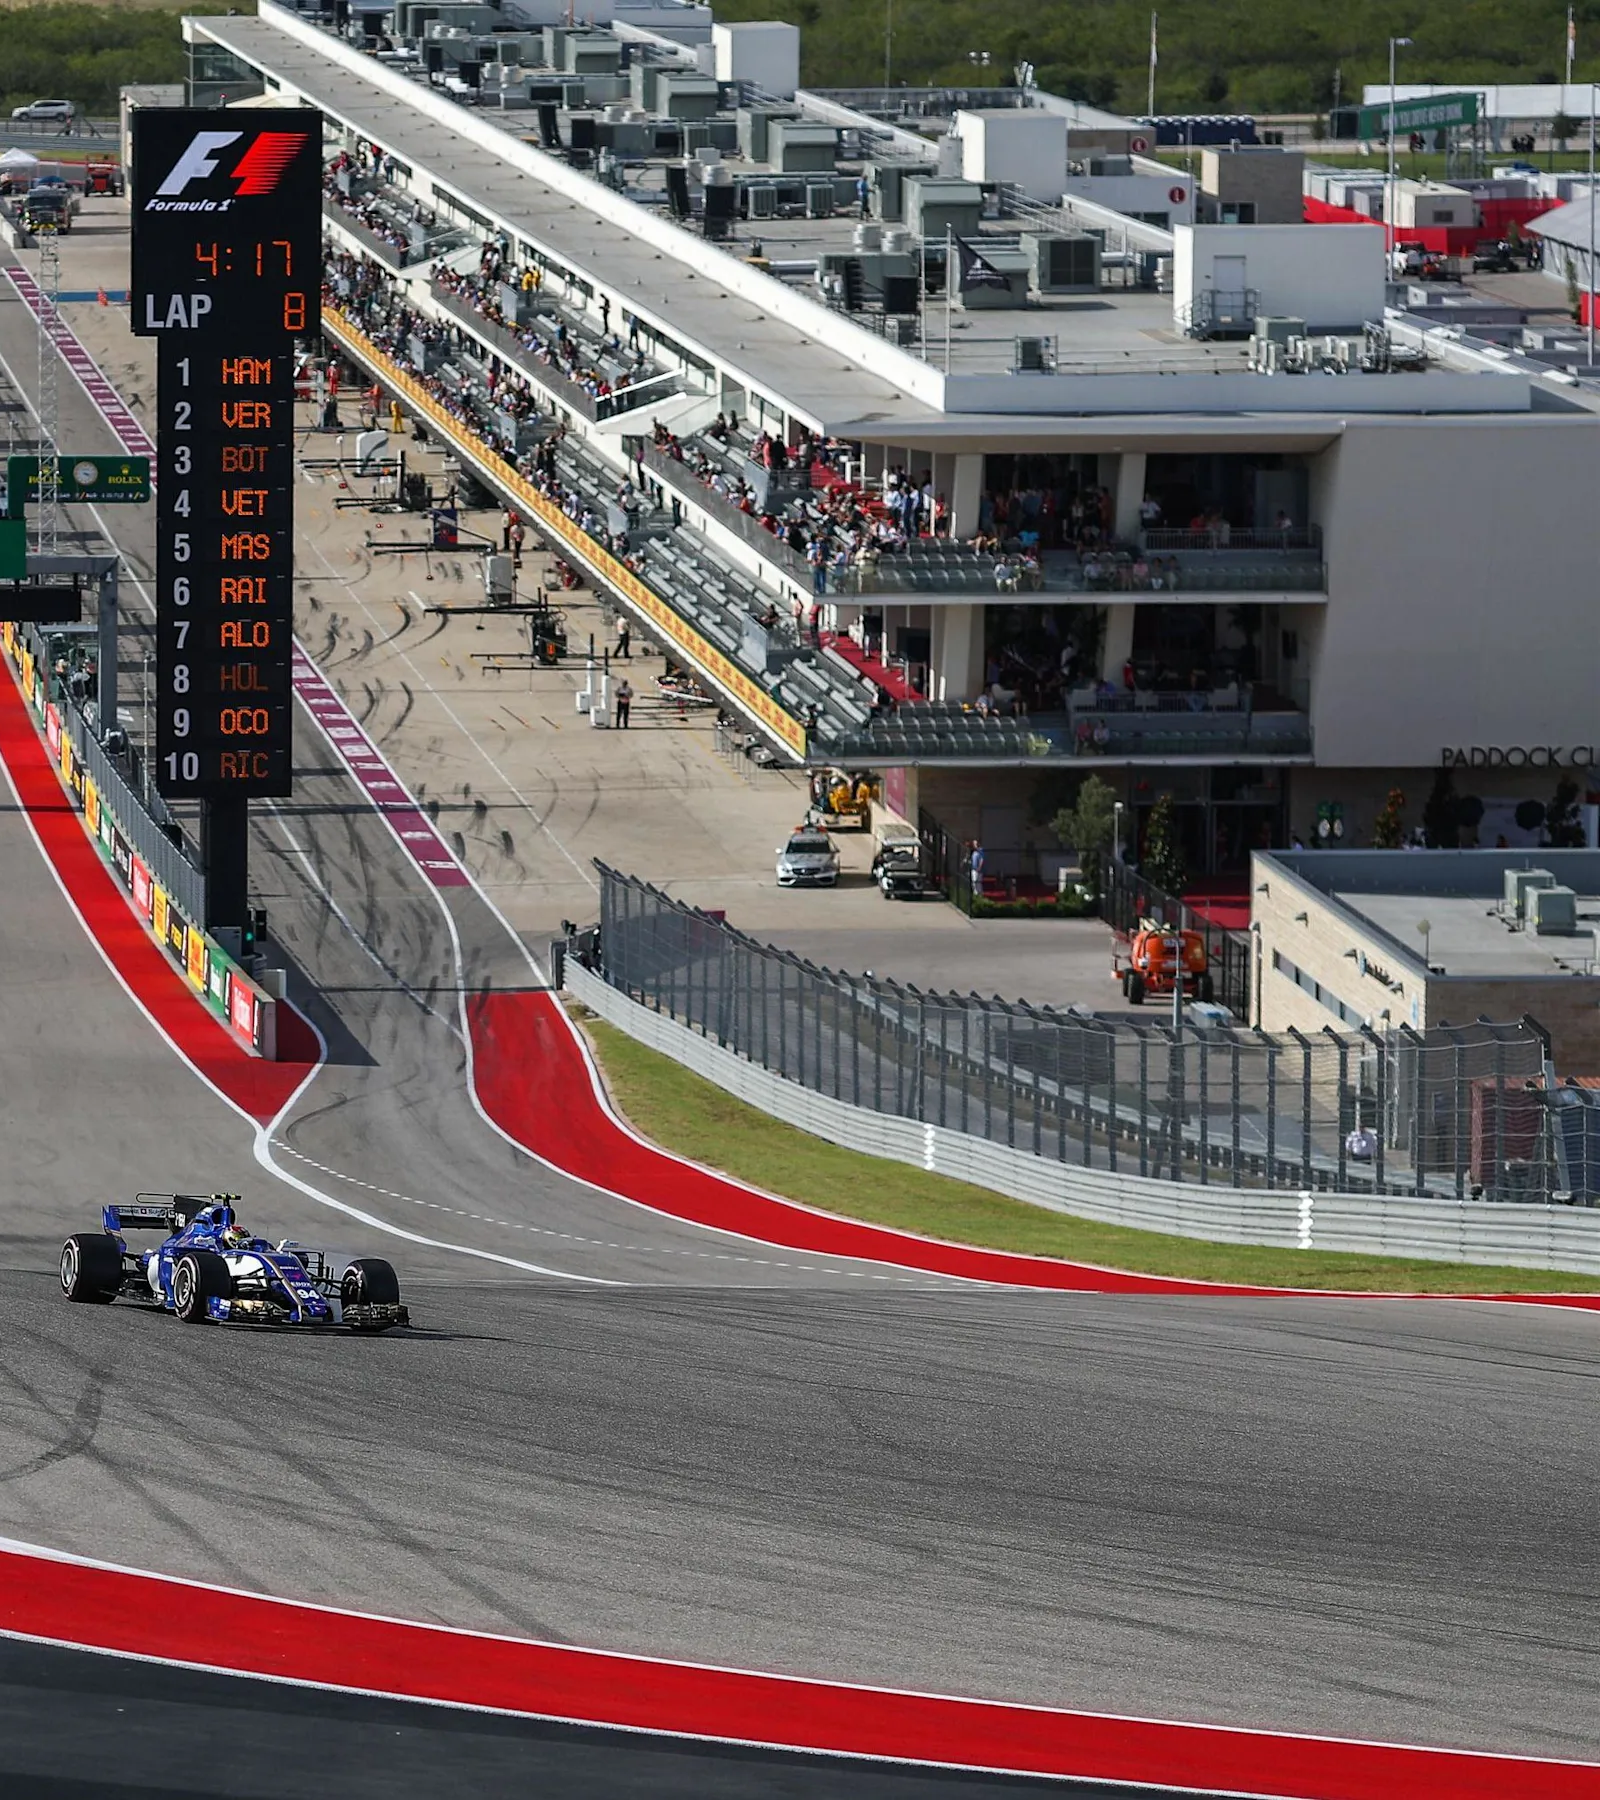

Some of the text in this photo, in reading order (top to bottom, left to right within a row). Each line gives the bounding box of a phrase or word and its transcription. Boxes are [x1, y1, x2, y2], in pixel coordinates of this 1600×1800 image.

[145, 198, 215, 212] Formula
[195, 240, 292, 277] 4:17
[145, 292, 306, 331] LAP 8
[176, 357, 271, 386] 1 HAM
[174, 401, 271, 430] 2 VER
[174, 445, 269, 474] 3 BOT
[108, 475, 143, 484] ROLEX
[174, 489, 269, 517] 4 VET
[174, 533, 271, 562] 5 MAS
[173, 577, 267, 606] 6 RAI
[173, 621, 270, 649] 7 ALO
[173, 664, 269, 693] 8 HUL
[173, 708, 269, 737] 9 OCO
[164, 752, 269, 781] 10 RIC
[1441, 745, 1564, 769] PADDOCK
[296, 1289, 320, 1300] 94
